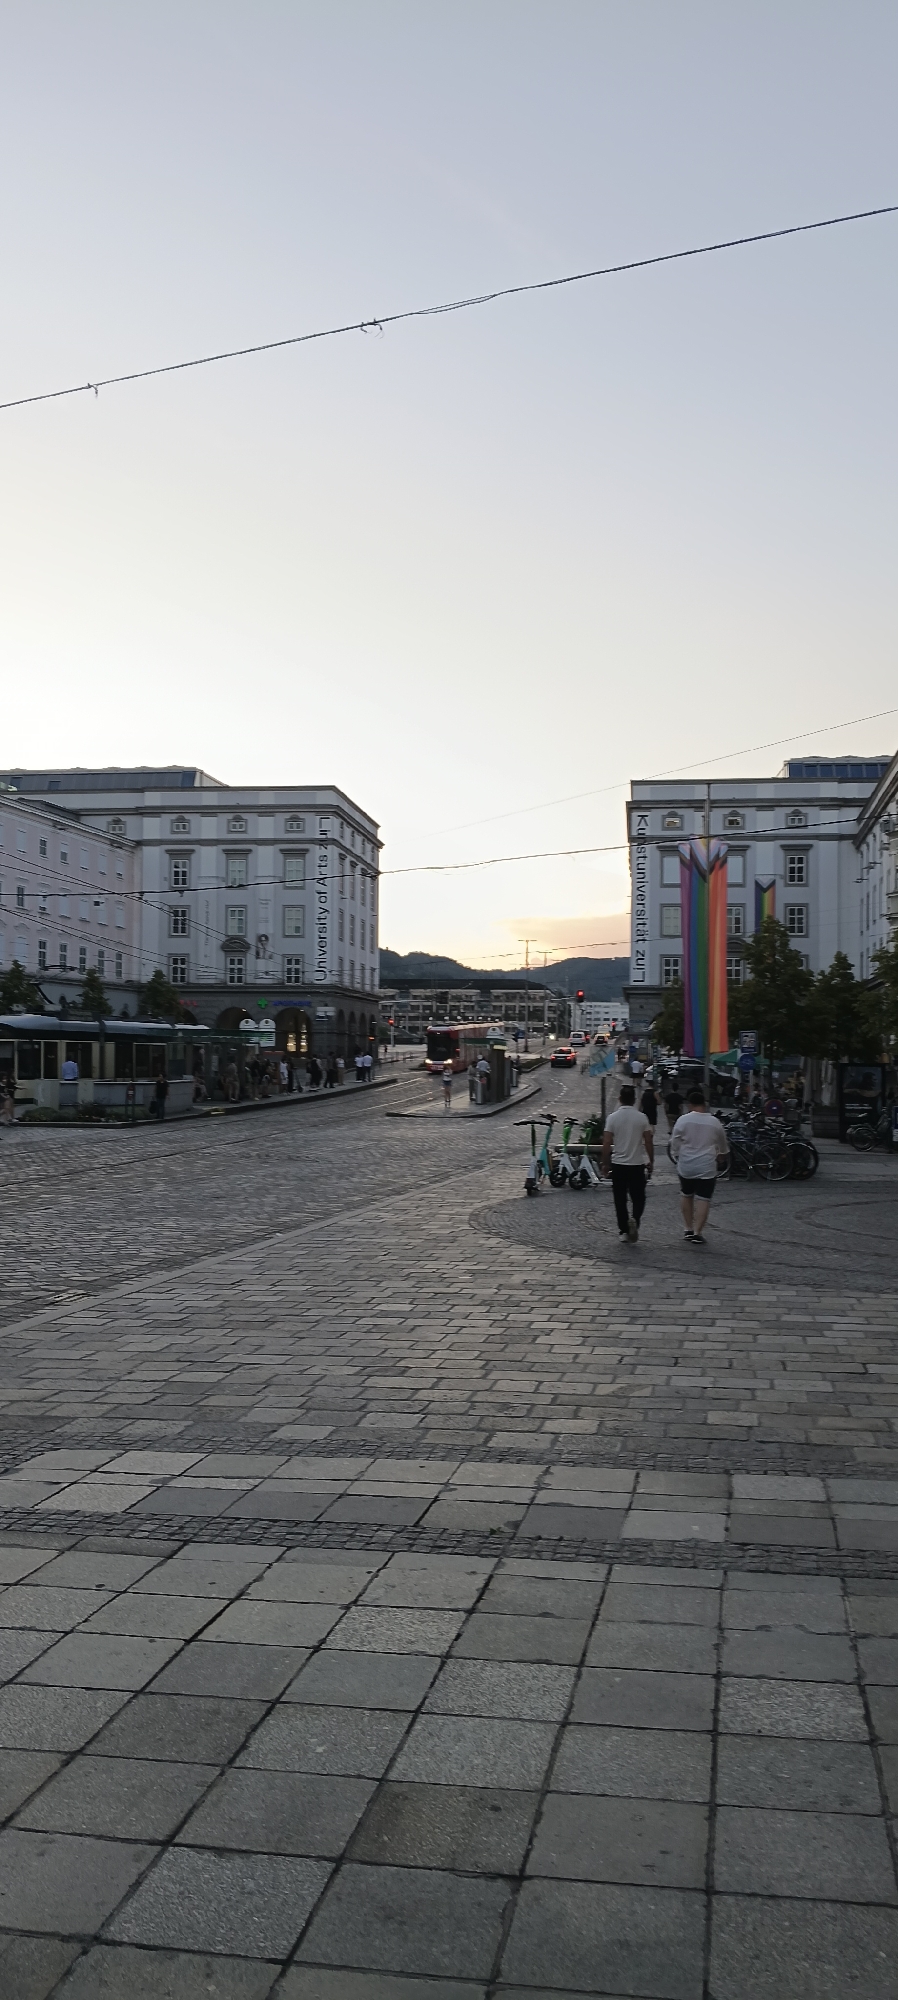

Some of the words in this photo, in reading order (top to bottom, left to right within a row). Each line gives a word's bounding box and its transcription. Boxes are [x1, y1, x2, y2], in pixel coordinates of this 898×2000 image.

[315, 890, 328, 904] of
[316, 855, 328, 887] Arts
[636, 814, 649, 944] Kunstuniversität
[314, 906, 330, 982] University
